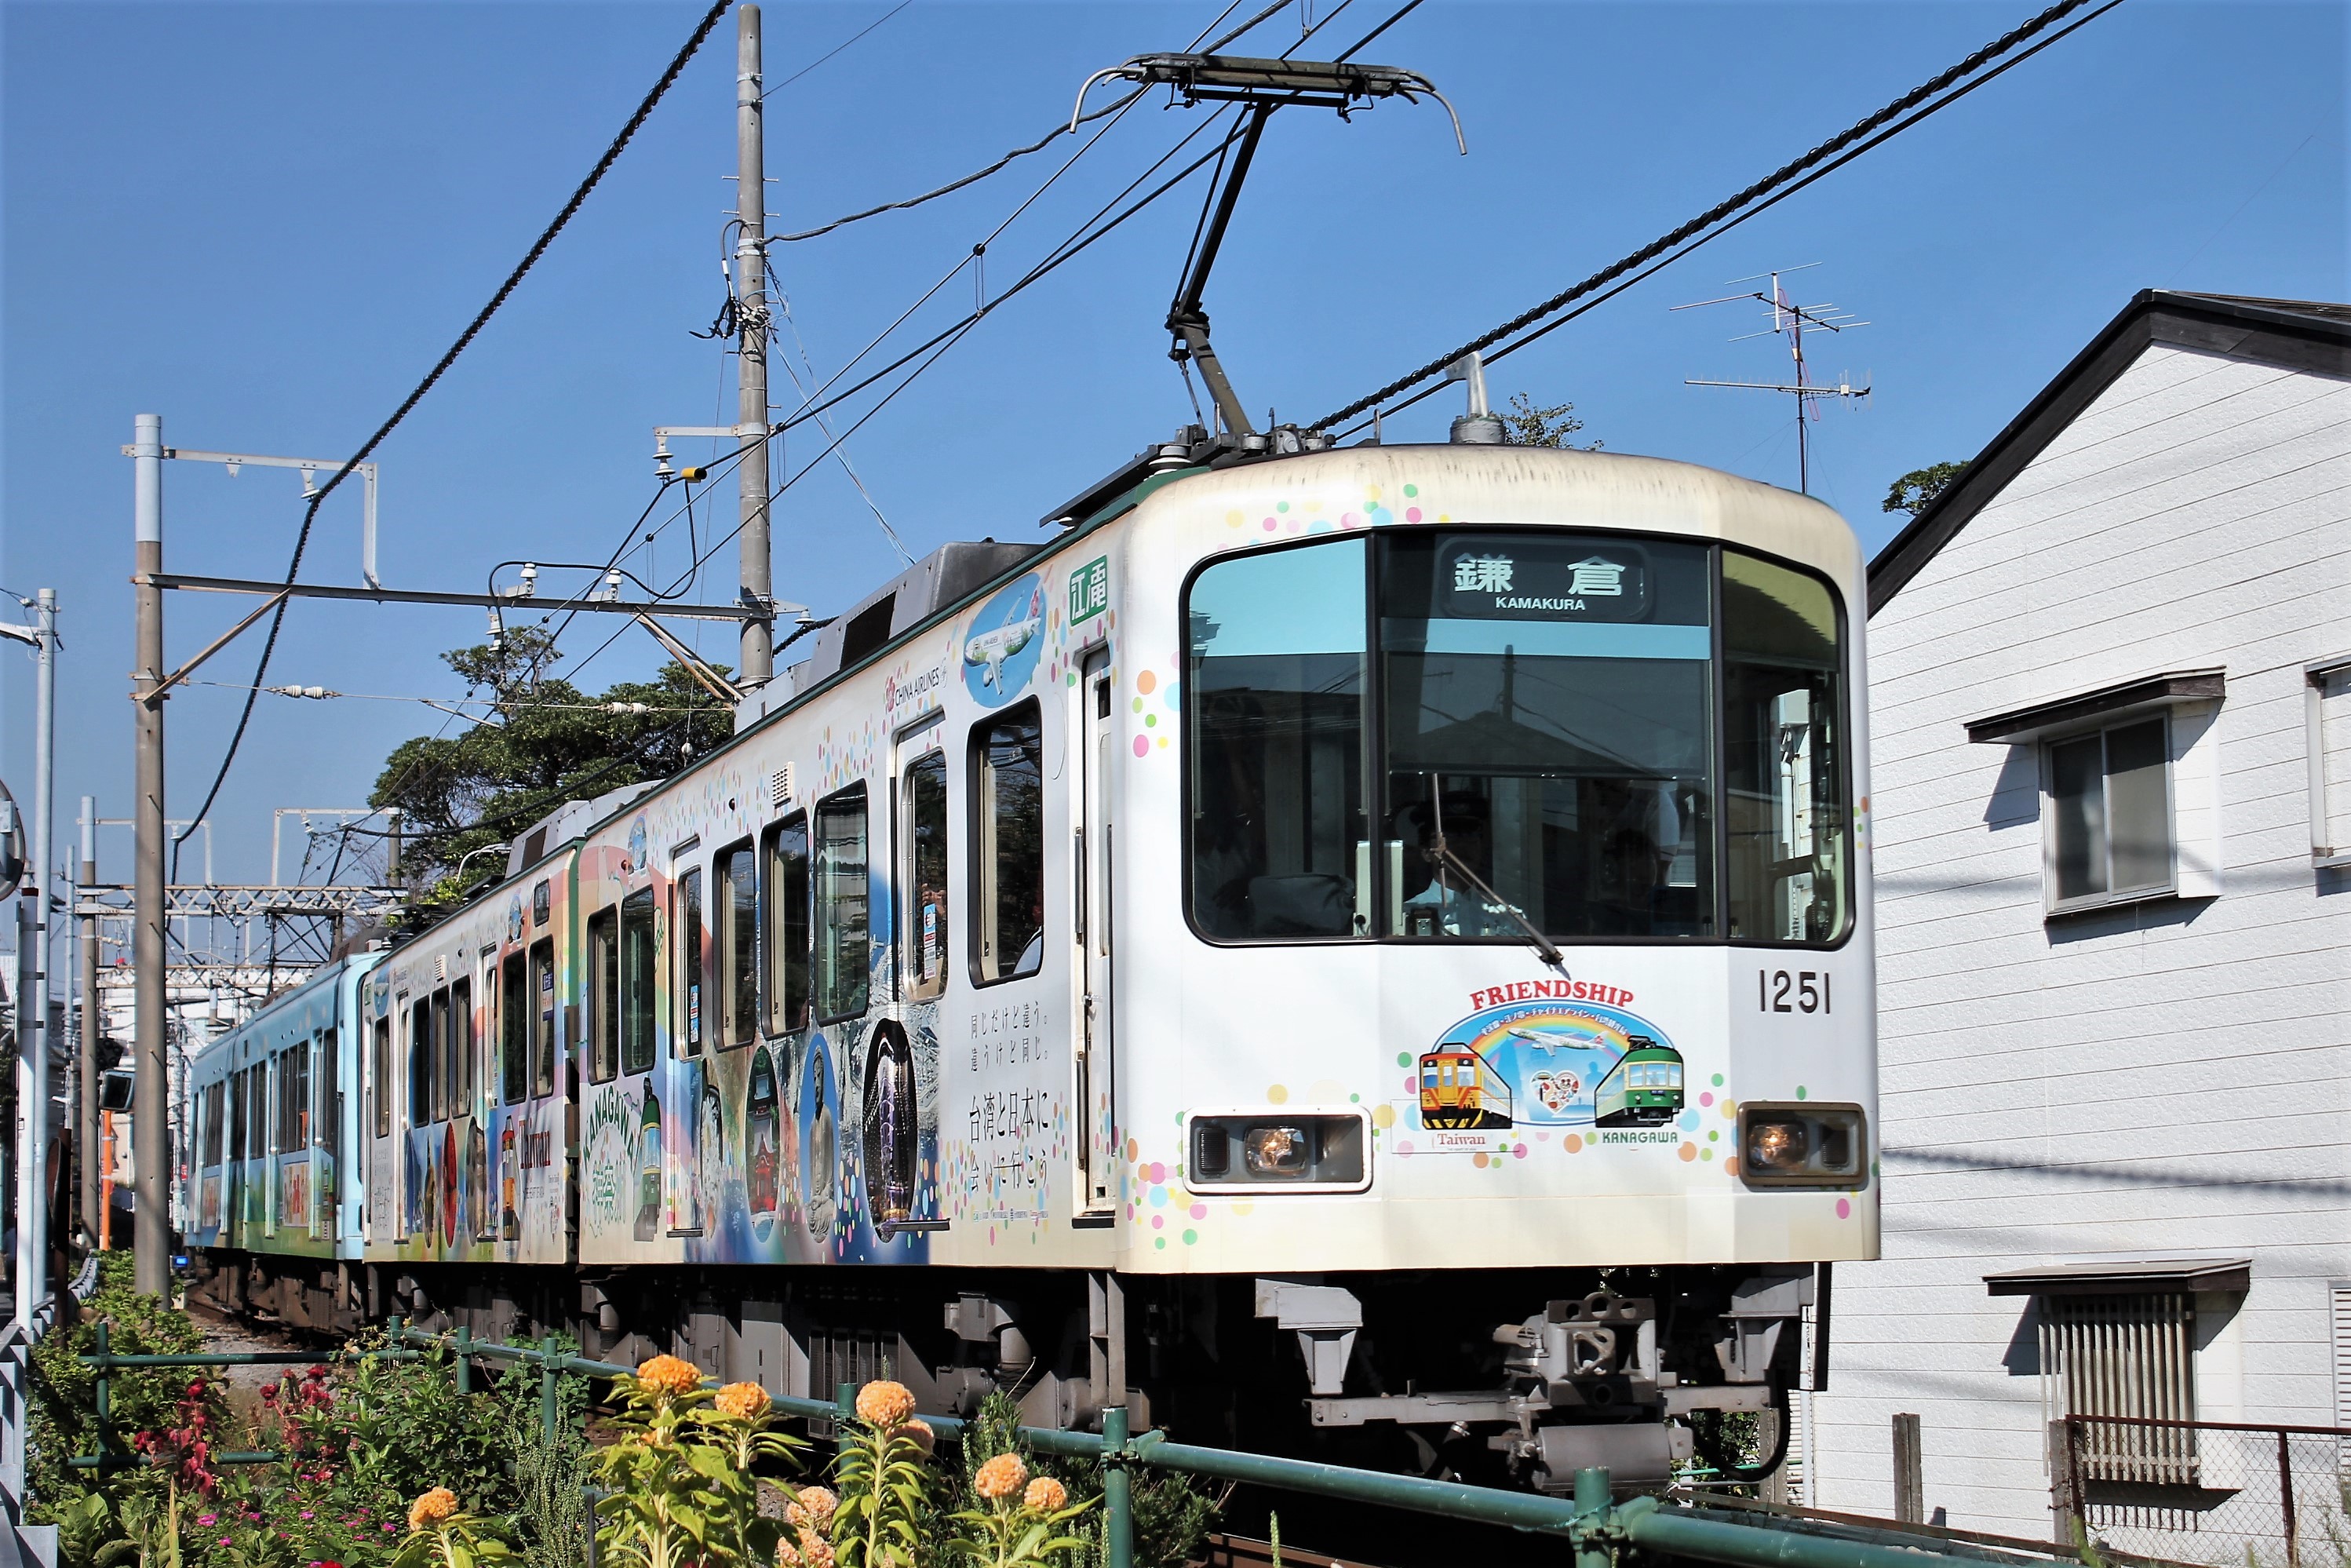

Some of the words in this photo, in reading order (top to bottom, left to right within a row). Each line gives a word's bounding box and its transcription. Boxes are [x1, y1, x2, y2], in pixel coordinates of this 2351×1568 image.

[1454, 552, 1626, 596] 鎌倉
[1495, 596, 1586, 611] KAMAKURA
[895, 681, 913, 706] CHINA
[913, 666, 940, 698] AIRLINES
[1470, 979, 1634, 1011] FRIENDSHIP
[1759, 969, 1831, 1015] 1251
[970, 1001, 1048, 1040] 同じだけど違う。
[970, 1035, 1048, 1073] 違うけど同じ。
[582, 1085, 634, 1176] KANAGAWA
[968, 1087, 1049, 1144] 台湾と日本に
[519, 1118, 551, 1169] Taiwan
[1437, 1132, 1486, 1145] Taiwan
[1602, 1131, 1679, 1143] KANAGAWA
[592, 1158, 626, 1225] 神奈川
[969, 1148, 1048, 1193] 会いに行こう
